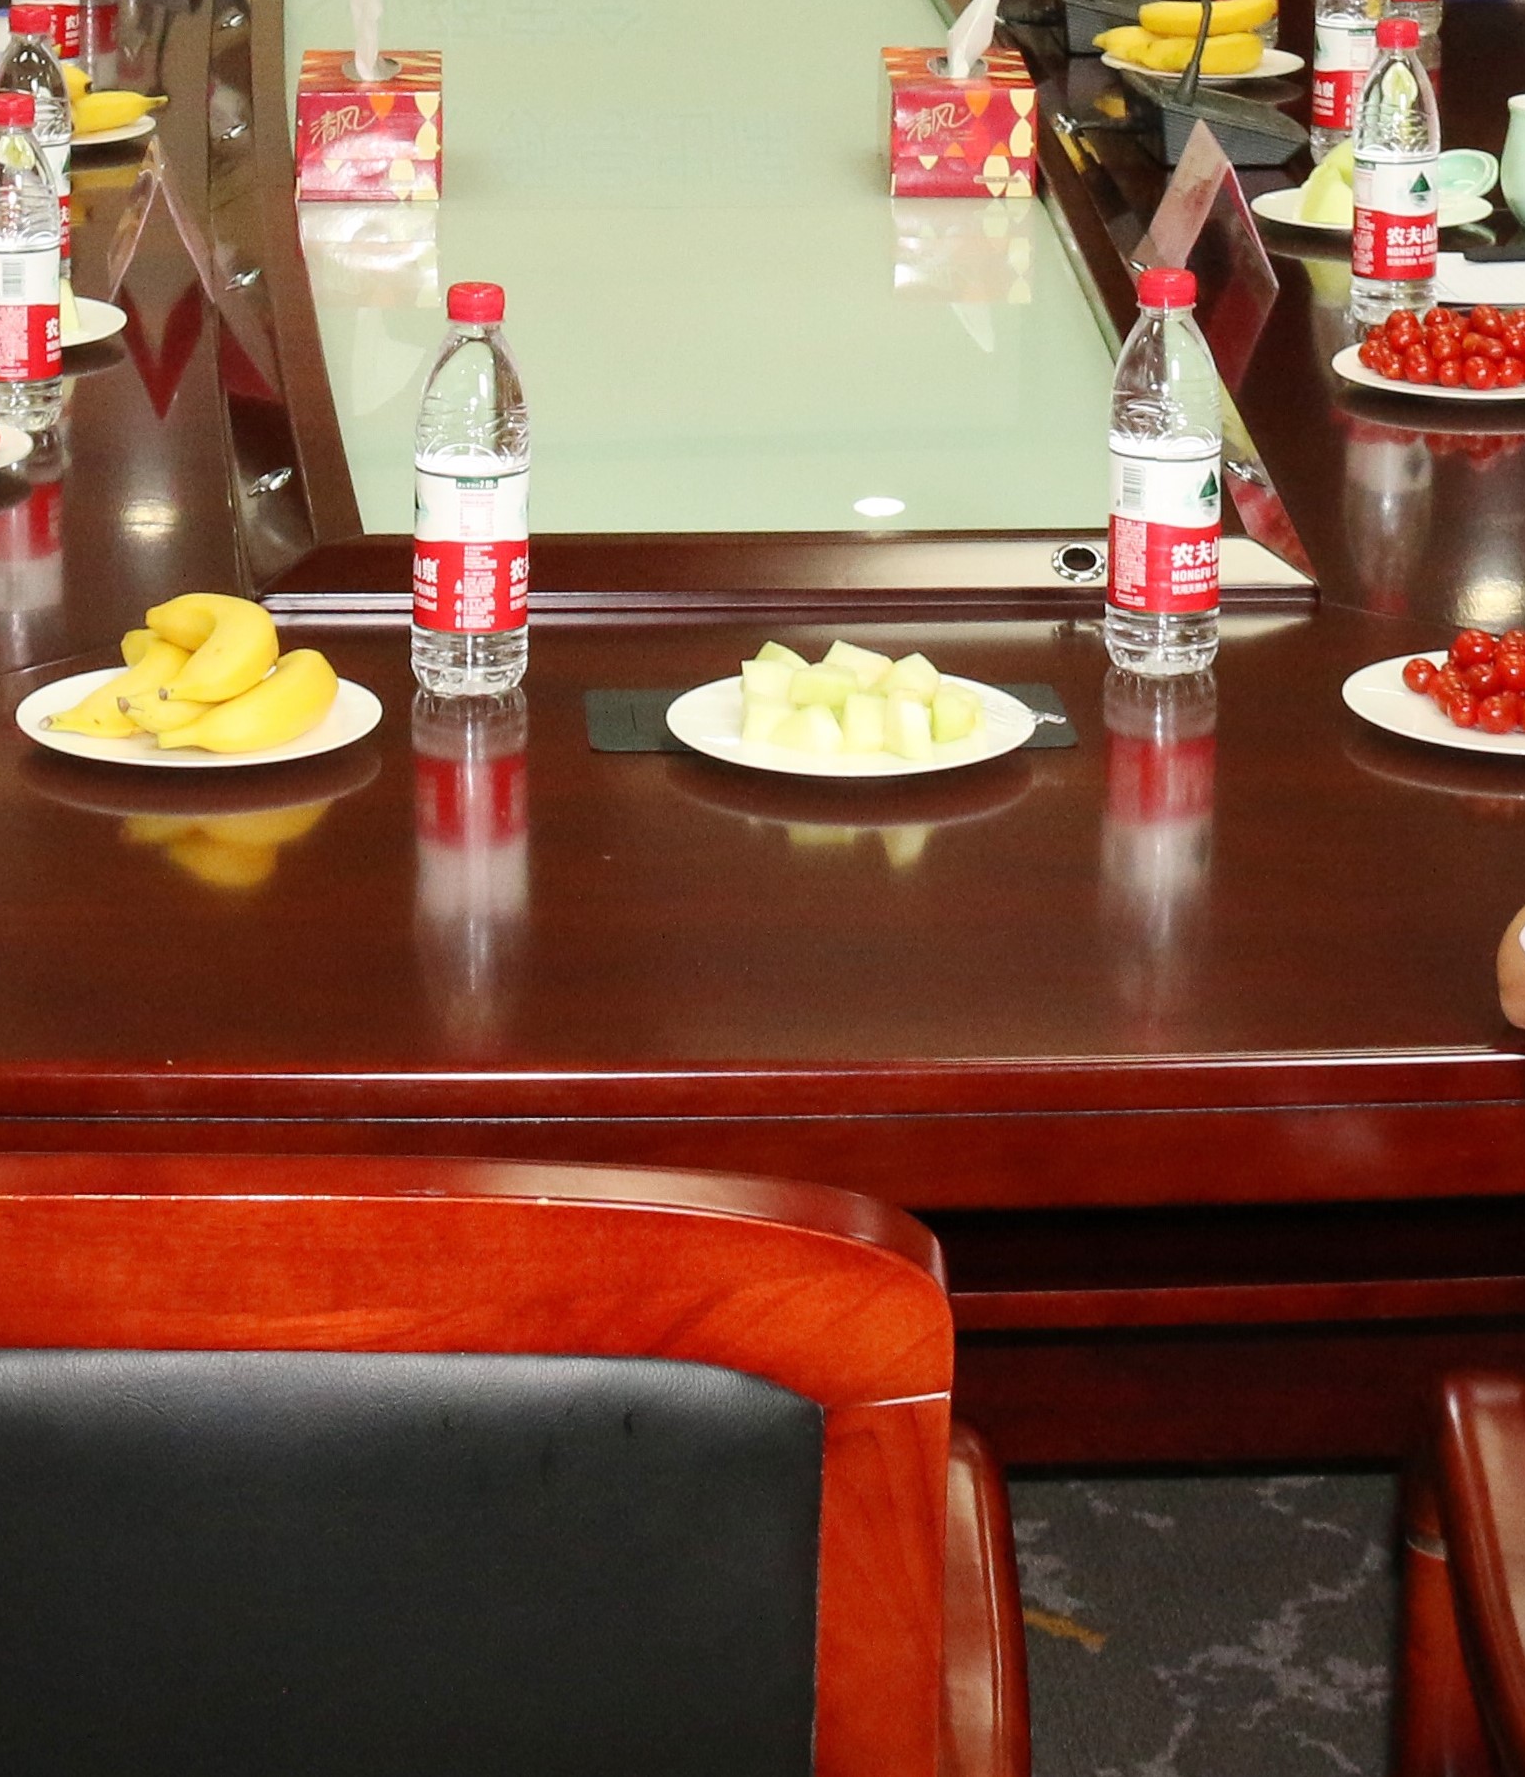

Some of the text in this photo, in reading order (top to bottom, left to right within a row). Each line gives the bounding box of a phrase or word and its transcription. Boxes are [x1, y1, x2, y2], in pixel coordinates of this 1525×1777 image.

[308, 104, 379, 145] 清风
[1385, 222, 1438, 246] 农夫山
[1170, 566, 1212, 583] NONGFU
